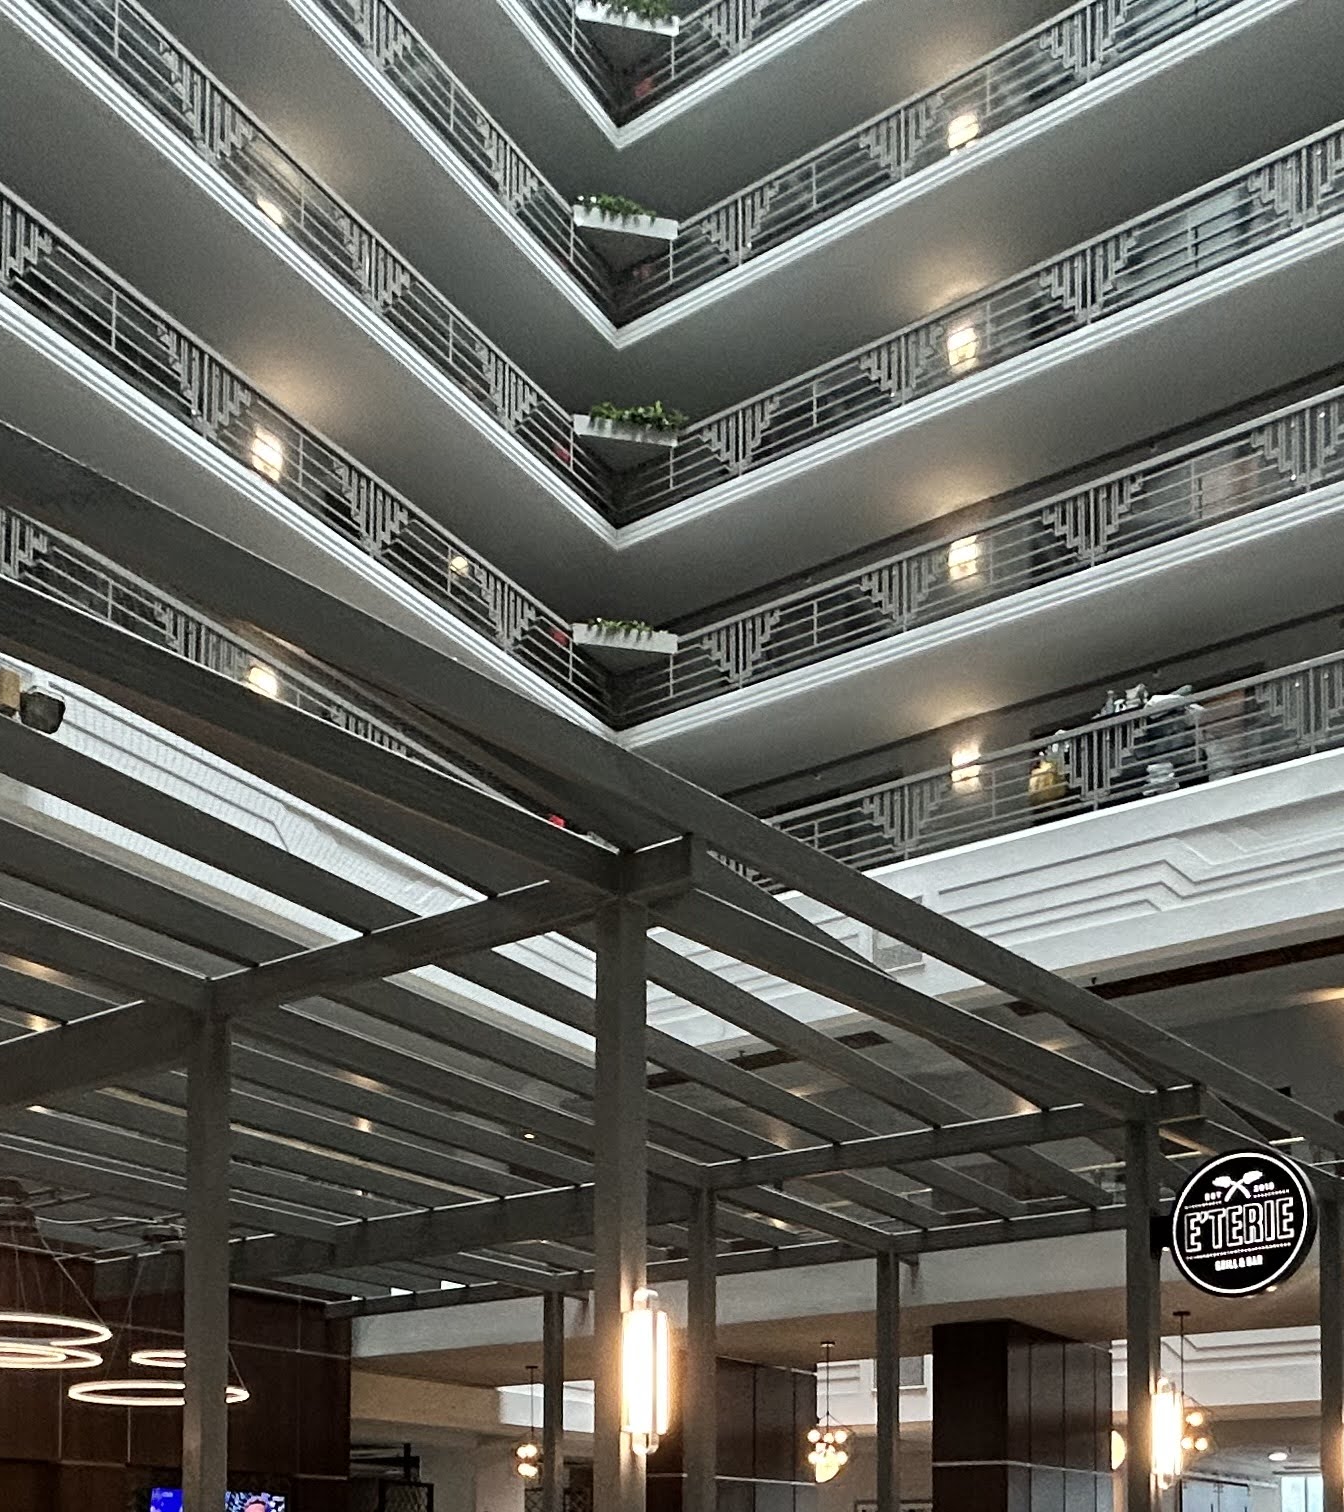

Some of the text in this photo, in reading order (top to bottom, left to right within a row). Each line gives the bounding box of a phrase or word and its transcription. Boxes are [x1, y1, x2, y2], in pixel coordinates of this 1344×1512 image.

[1184, 1197, 1295, 1253] E'TERIE
[1214, 1258, 1238, 1271] GRILL
[1246, 1255, 1263, 1267] BAR
